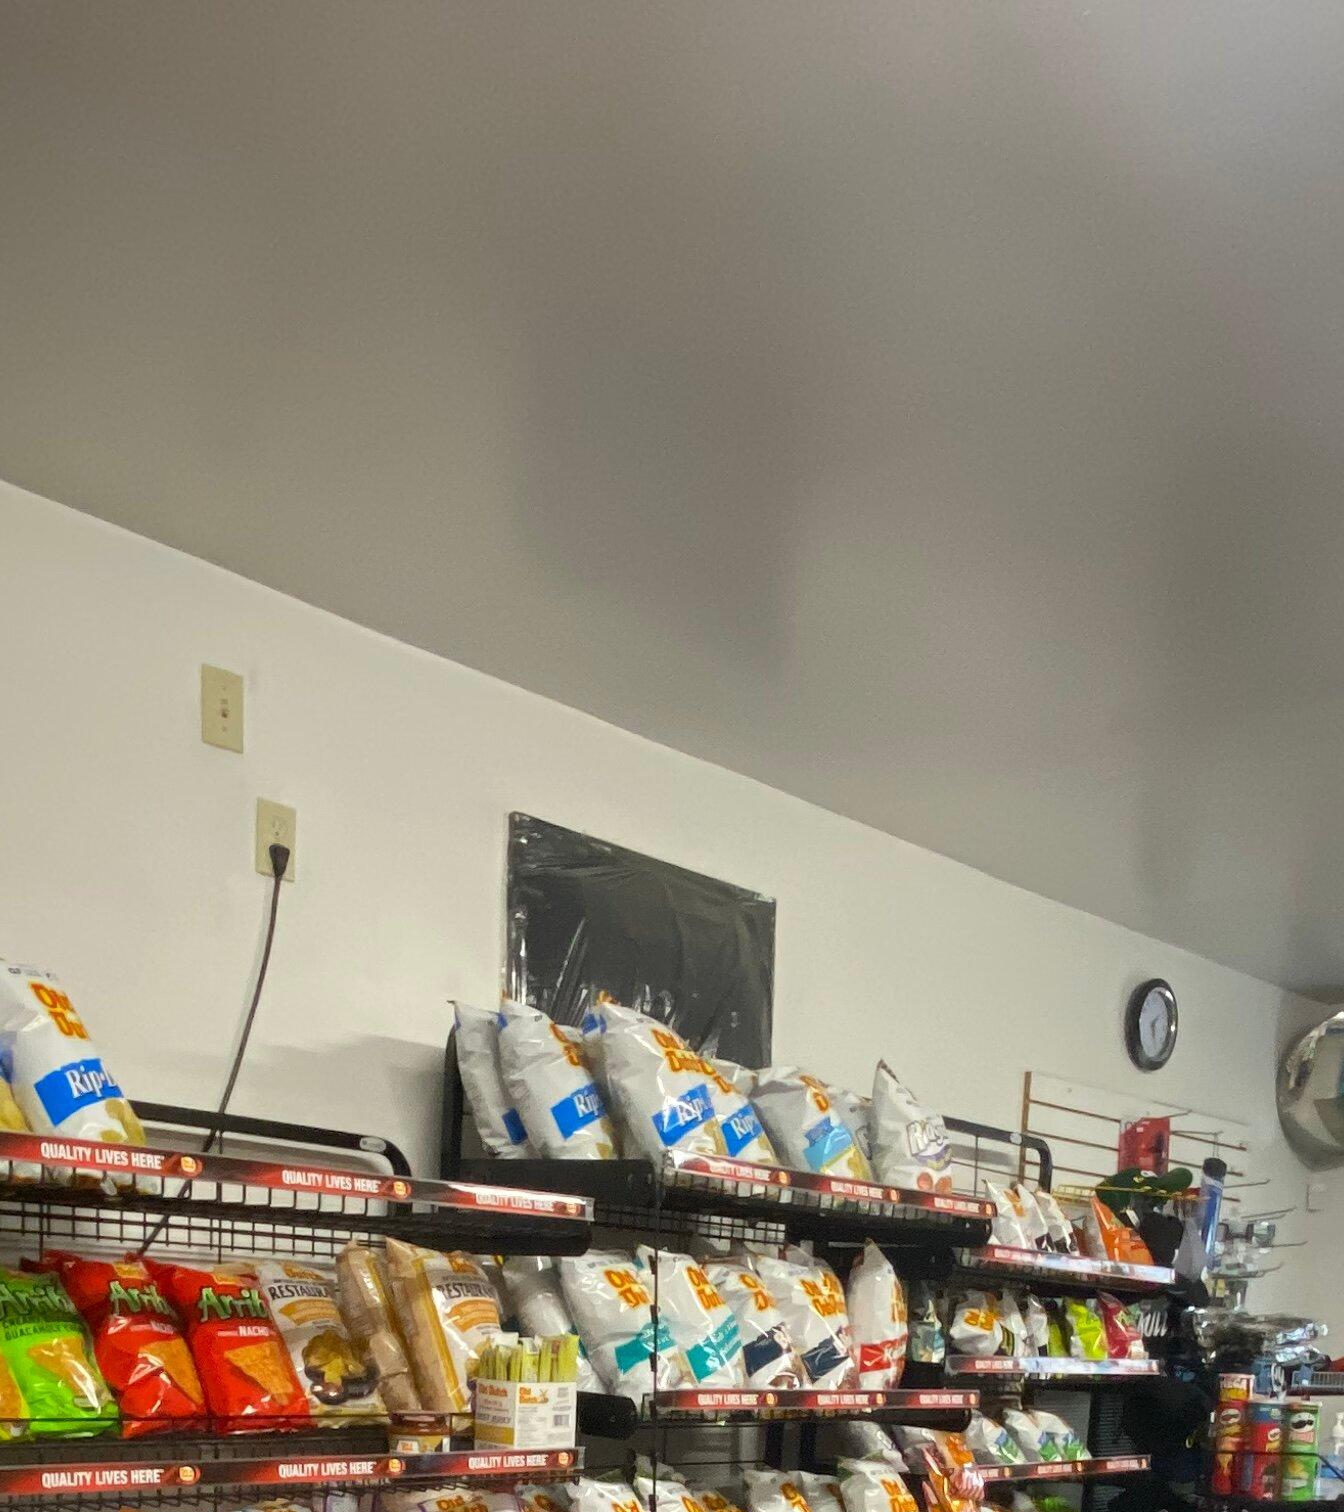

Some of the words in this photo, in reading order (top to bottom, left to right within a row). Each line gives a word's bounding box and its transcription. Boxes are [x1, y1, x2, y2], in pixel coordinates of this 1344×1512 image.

[40, 1141, 91, 1162] QUALITY
[95, 1147, 128, 1167] LIVES
[131, 1151, 164, 1169] HERE
[281, 1169, 323, 1188] QUALITY
[325, 1174, 353, 1191] LIVES
[354, 1178, 381, 1194] HERE
[278, 1462, 317, 1479] QUALITY
[319, 1462, 348, 1476] LIVES
[349, 1461, 377, 1475] HERE
[468, 1456, 503, 1469] QUALITY
[504, 1456, 525, 1467] LIVES
[527, 1455, 548, 1466] HERE
[42, 1470, 92, 1489] QUALITY
[95, 1470, 128, 1486] LIVES
[130, 1468, 164, 1485] HERE
